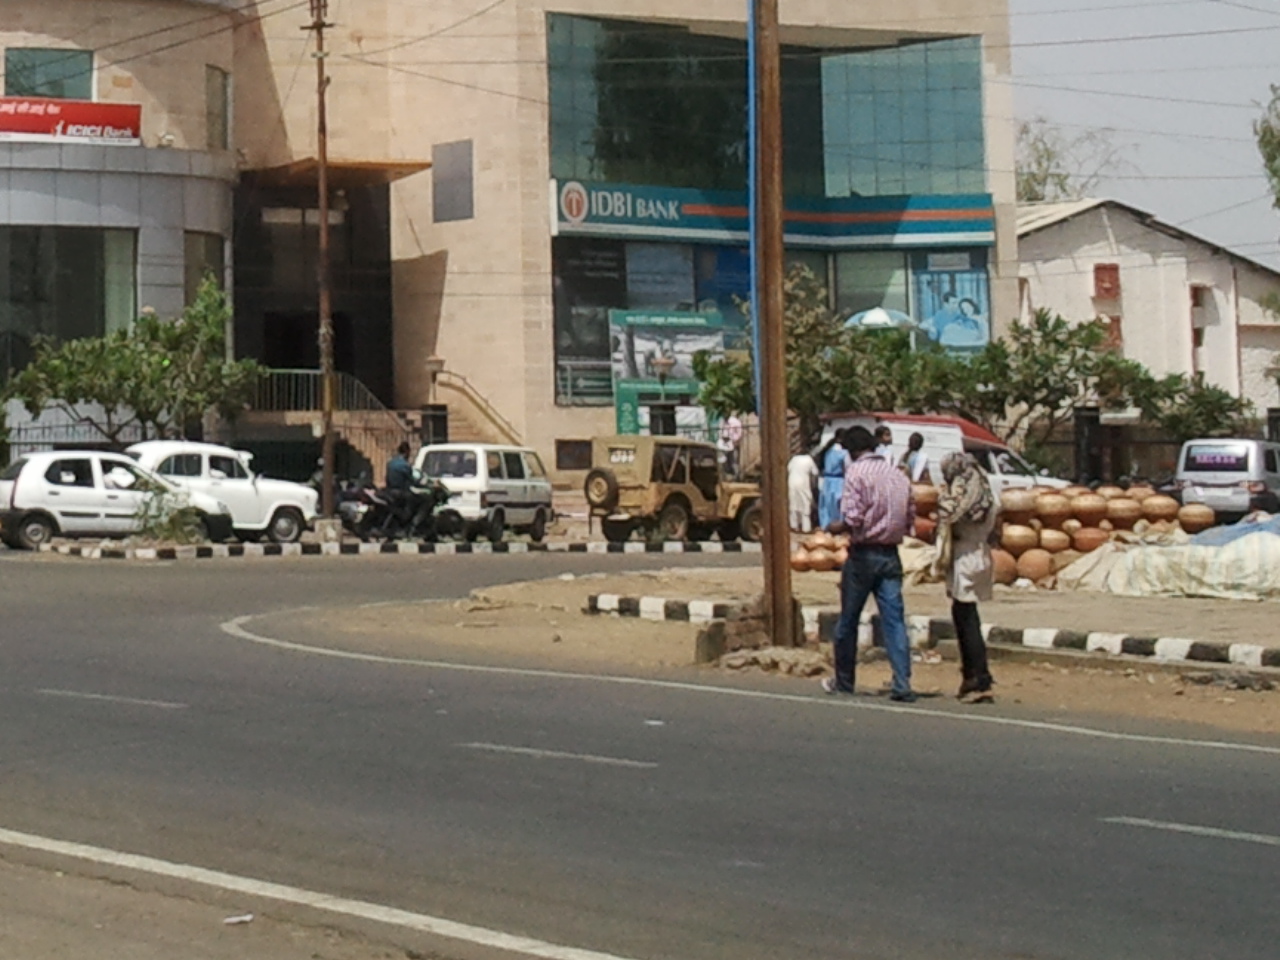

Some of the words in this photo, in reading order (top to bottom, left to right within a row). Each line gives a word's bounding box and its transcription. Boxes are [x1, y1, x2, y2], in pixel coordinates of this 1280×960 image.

[66, 124, 102, 137] ICICI
[103, 125, 132, 138] Bank
[591, 190, 632, 218] IDBI
[636, 198, 679, 220] BANK
